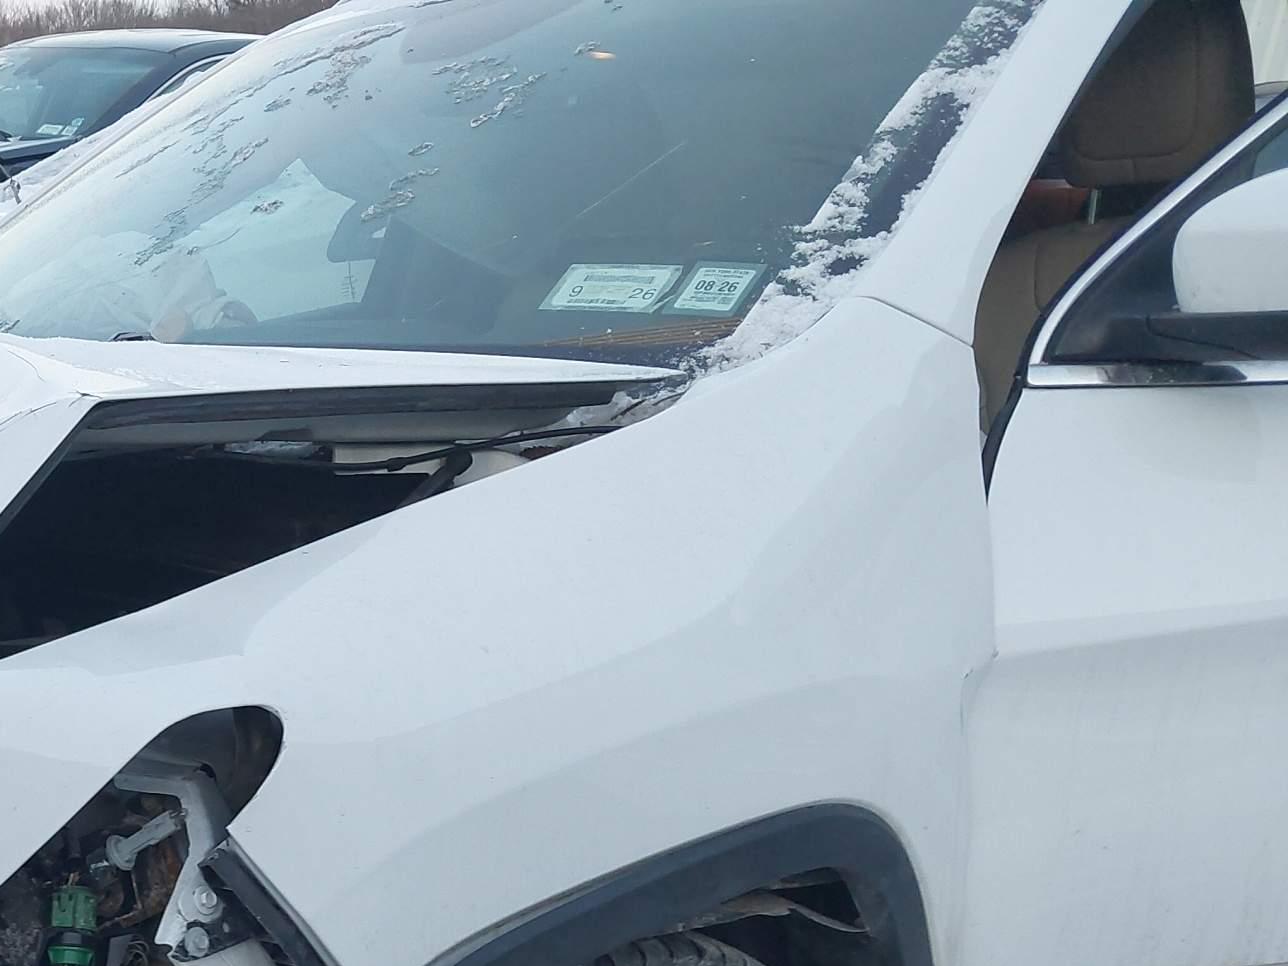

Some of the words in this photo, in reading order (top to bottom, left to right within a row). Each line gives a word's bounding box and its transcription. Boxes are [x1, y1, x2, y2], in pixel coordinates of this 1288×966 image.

[568, 285, 584, 298] 9
[628, 287, 657, 301] 26
[694, 279, 716, 292] 08
[717, 280, 740, 293] 26
